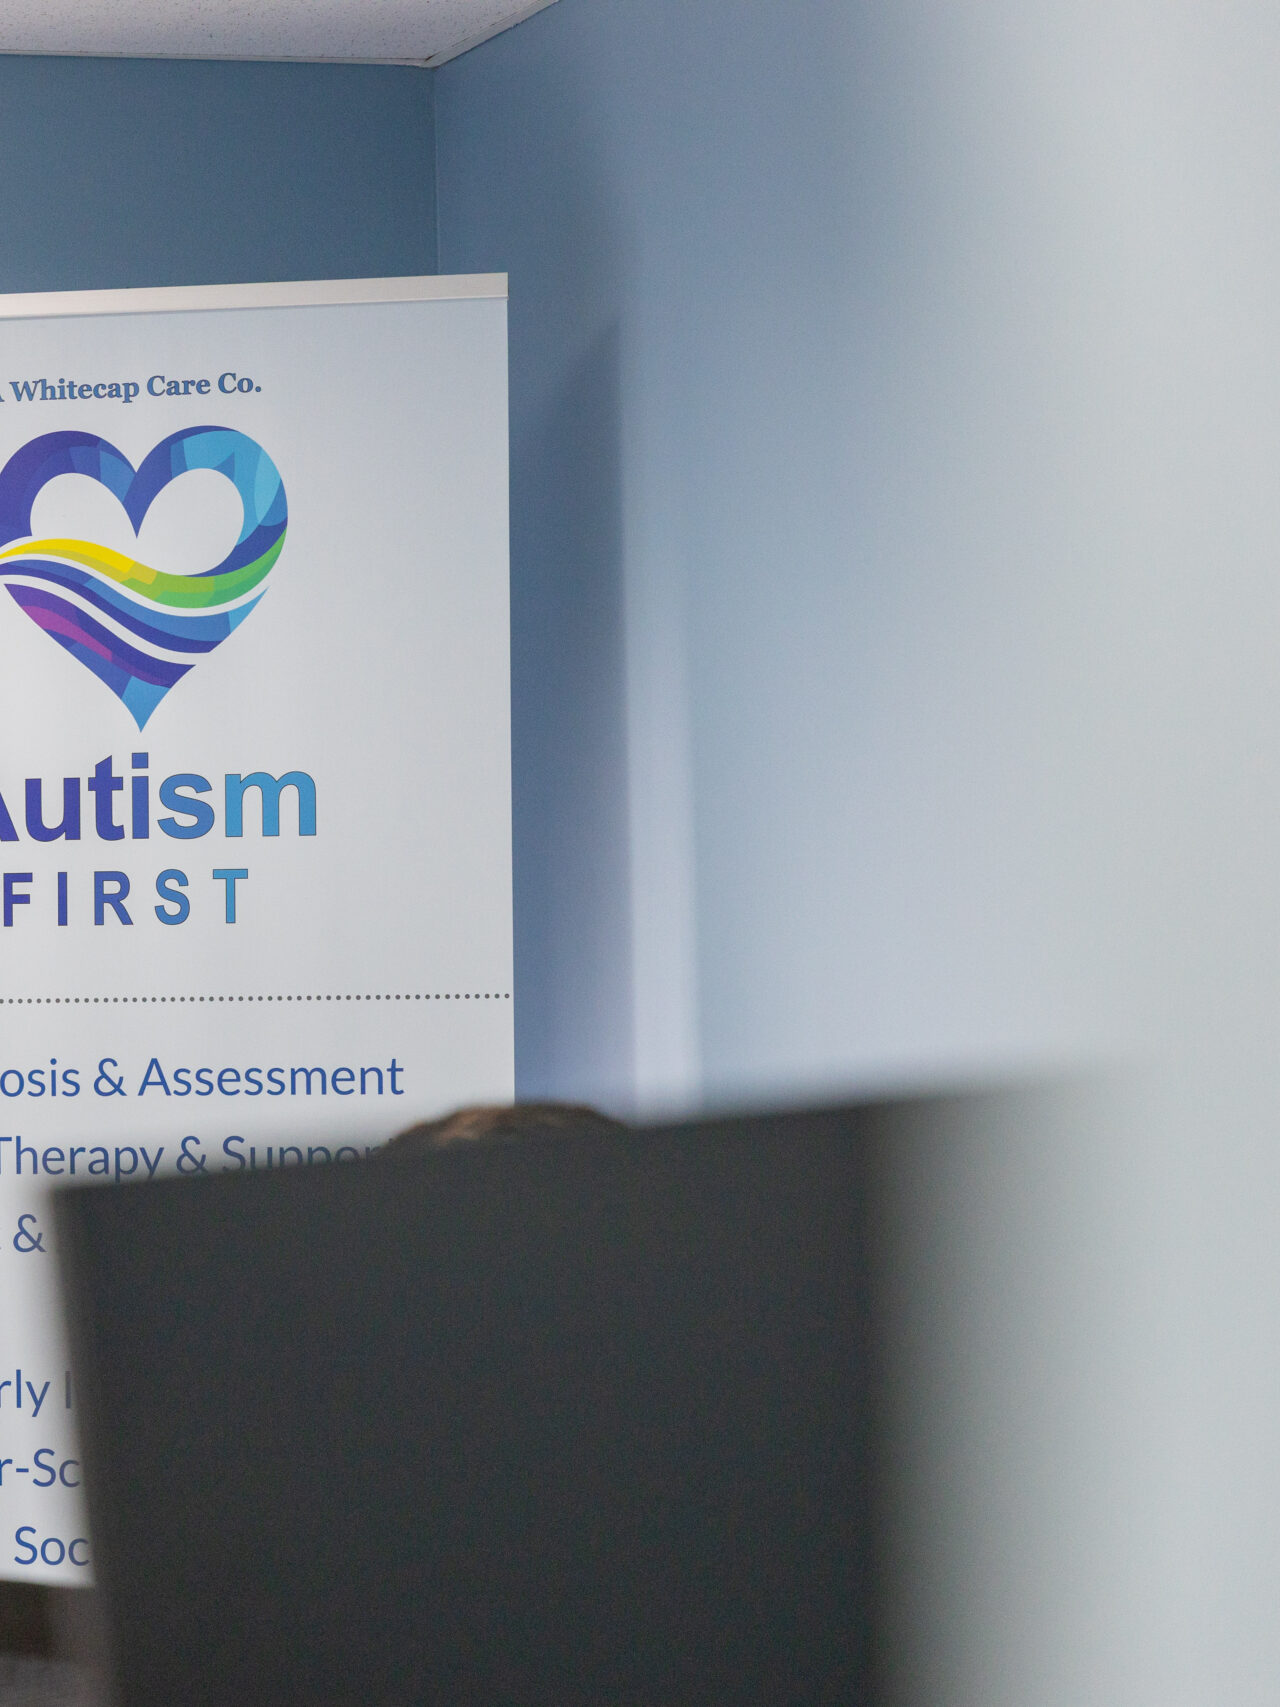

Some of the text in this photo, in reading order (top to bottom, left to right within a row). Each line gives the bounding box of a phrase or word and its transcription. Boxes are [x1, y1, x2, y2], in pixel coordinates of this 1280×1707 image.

[9, 378, 140, 403] Whitecap
[146, 375, 211, 396] Care
[217, 372, 262, 394] Co.
[2, 868, 249, 927] FIRST
[93, 1057, 127, 1096] &
[137, 1057, 405, 1097] Assessment
[175, 1136, 208, 1174] &
[222, 1135, 395, 1173] Suppo
[12, 1213, 47, 1253] &
[14, 1525, 91, 1567] Soc
